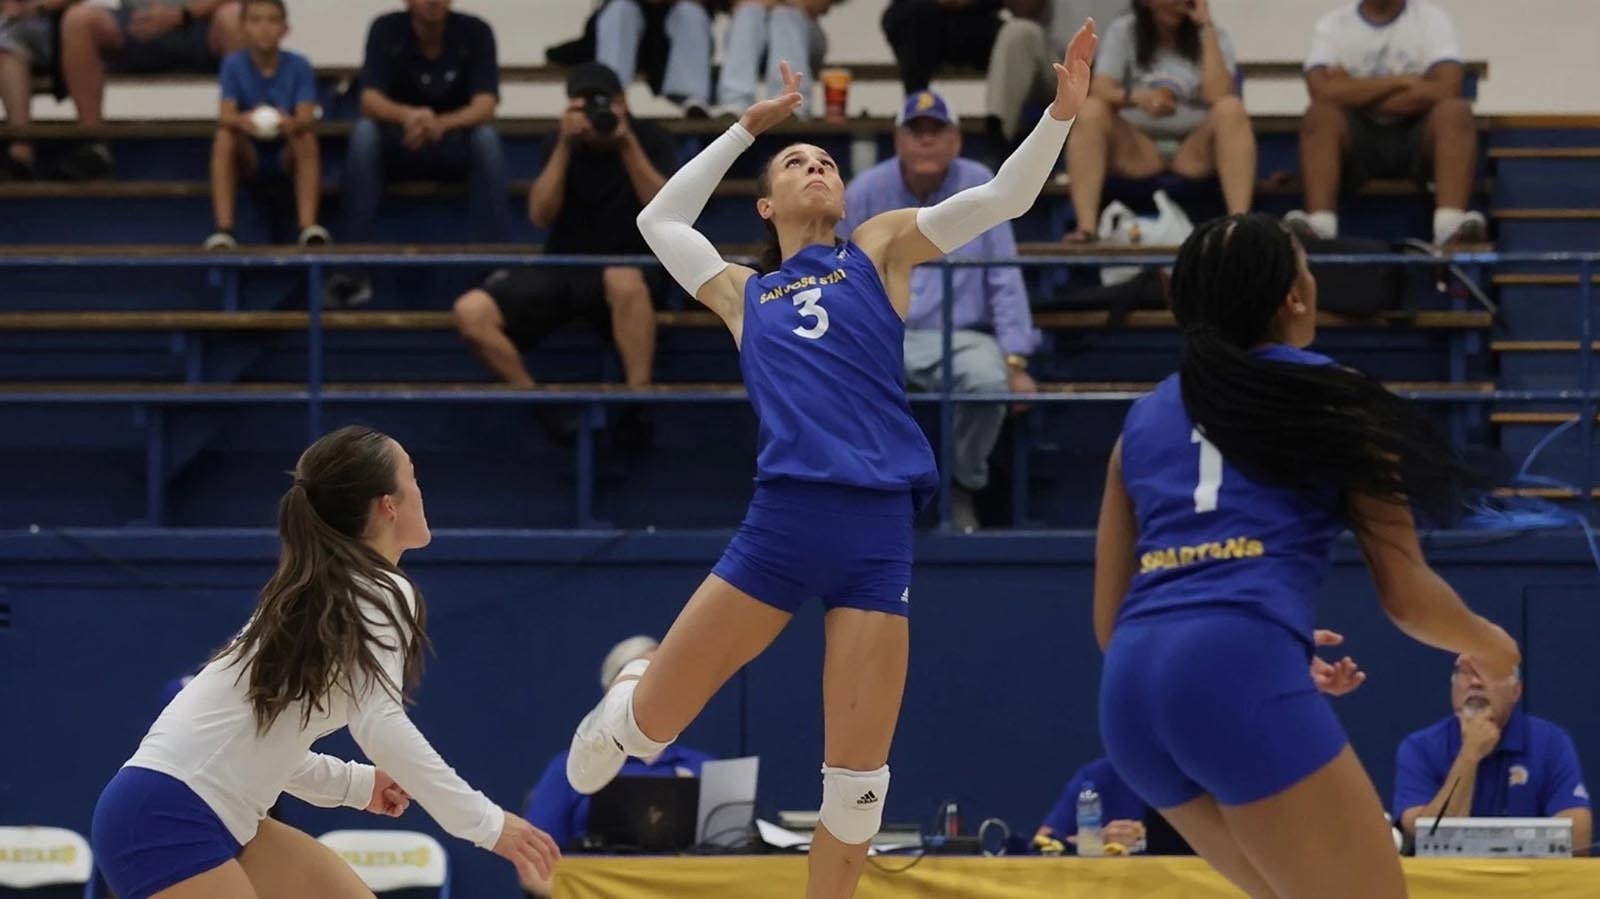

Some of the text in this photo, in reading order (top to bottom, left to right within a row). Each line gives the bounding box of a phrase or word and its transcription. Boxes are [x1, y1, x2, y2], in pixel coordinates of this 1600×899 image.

[760, 286, 783, 304] SAN
[783, 276, 816, 292] JOSE
[792, 287, 829, 339] 3
[1190, 425, 1223, 514] 1
